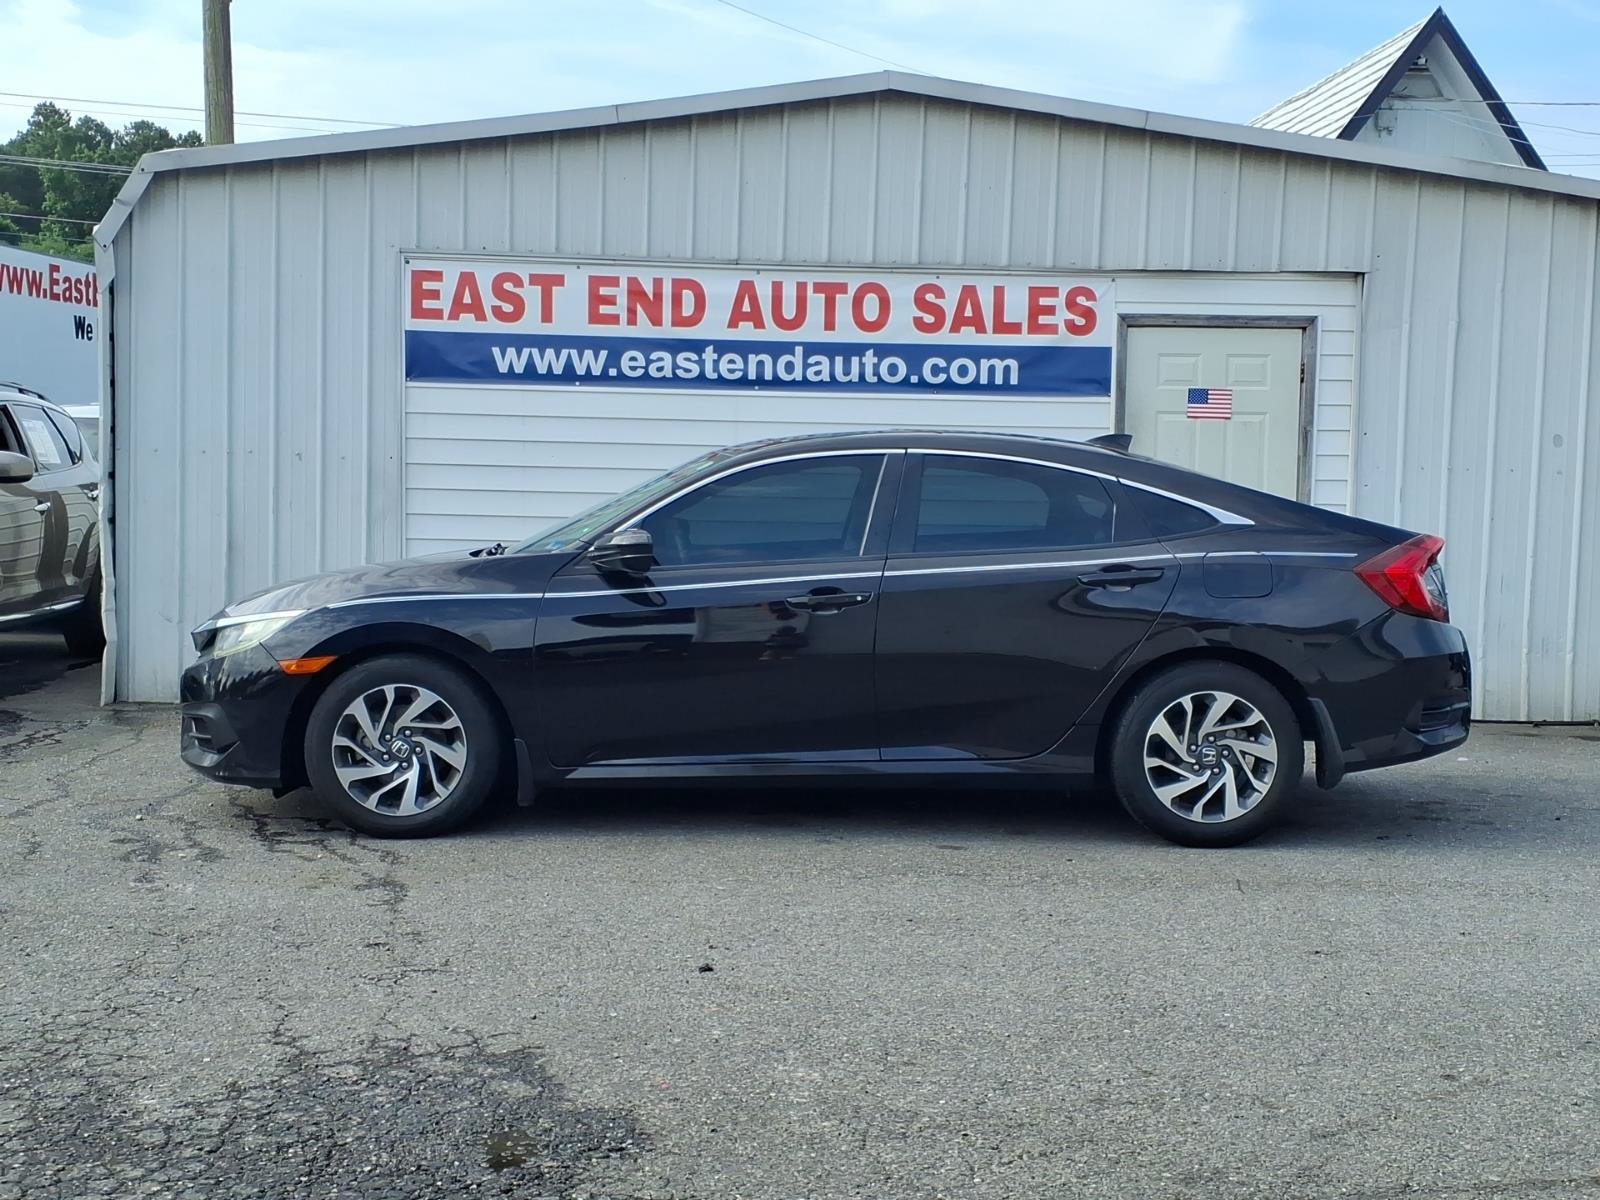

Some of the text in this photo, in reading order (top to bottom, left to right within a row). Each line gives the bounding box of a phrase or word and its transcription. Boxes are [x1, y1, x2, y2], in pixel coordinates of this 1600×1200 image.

[411, 270, 1098, 337] EAST END AUTO SALES
[73, 314, 93, 341] We
[491, 344, 1019, 386] www.eastendauto.com
